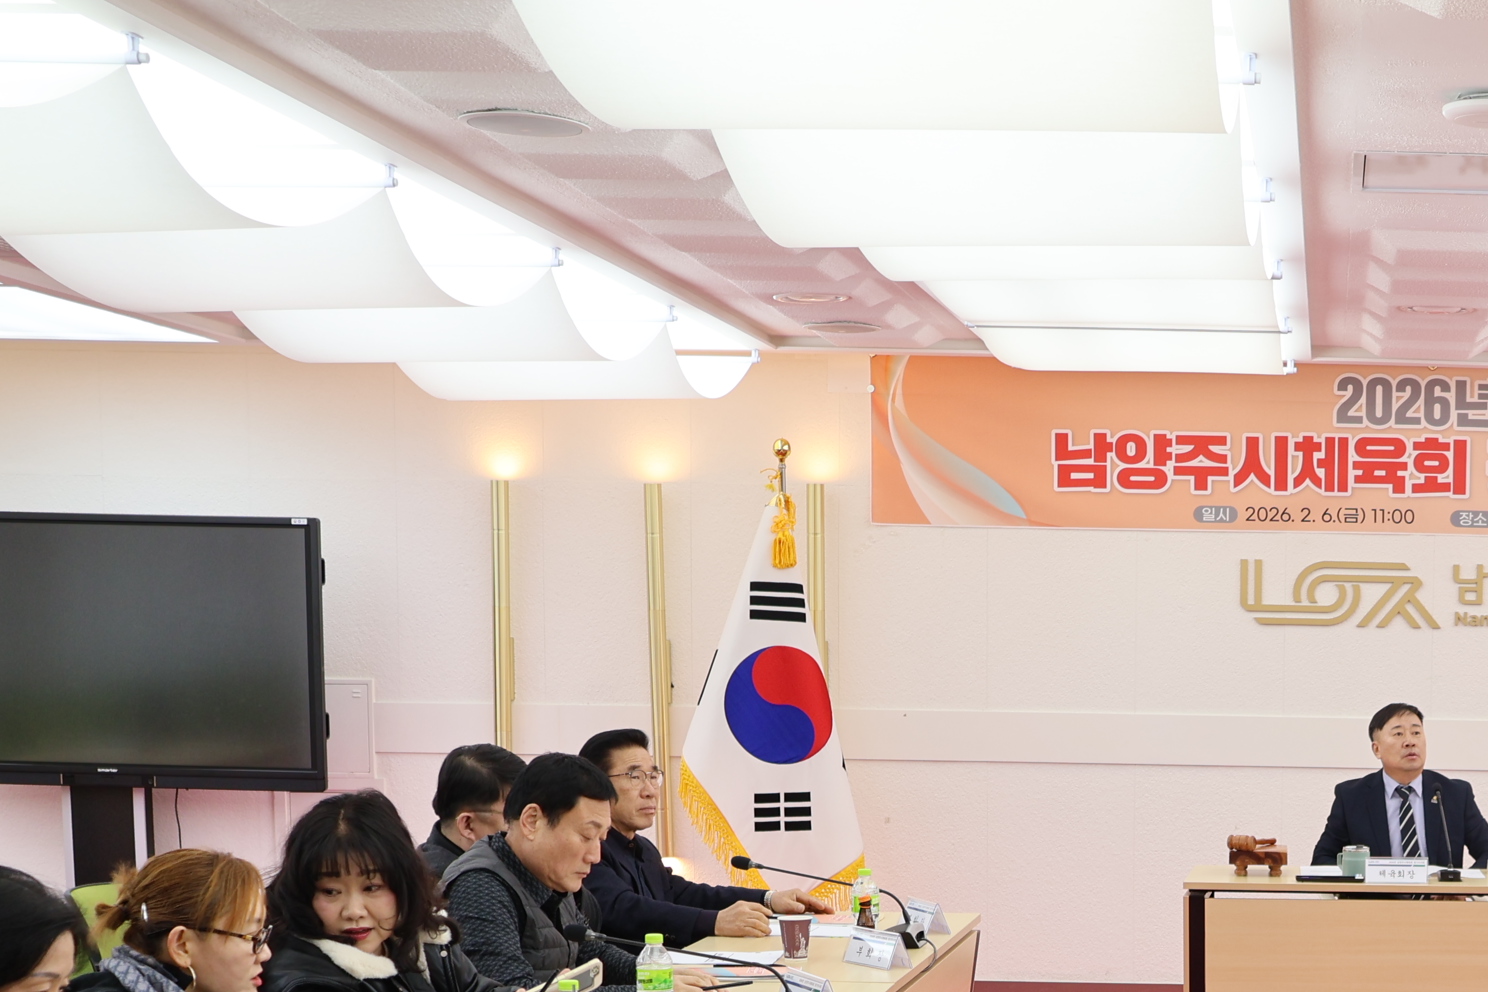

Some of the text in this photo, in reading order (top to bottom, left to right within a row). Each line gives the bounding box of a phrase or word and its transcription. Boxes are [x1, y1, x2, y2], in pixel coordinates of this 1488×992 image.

[1054, 432, 1468, 496] 남양주시체육회
[1201, 507, 1415, 525] 일시 2026. 2. 6.(금) 11:00
[1459, 511, 1488, 527] 장소
